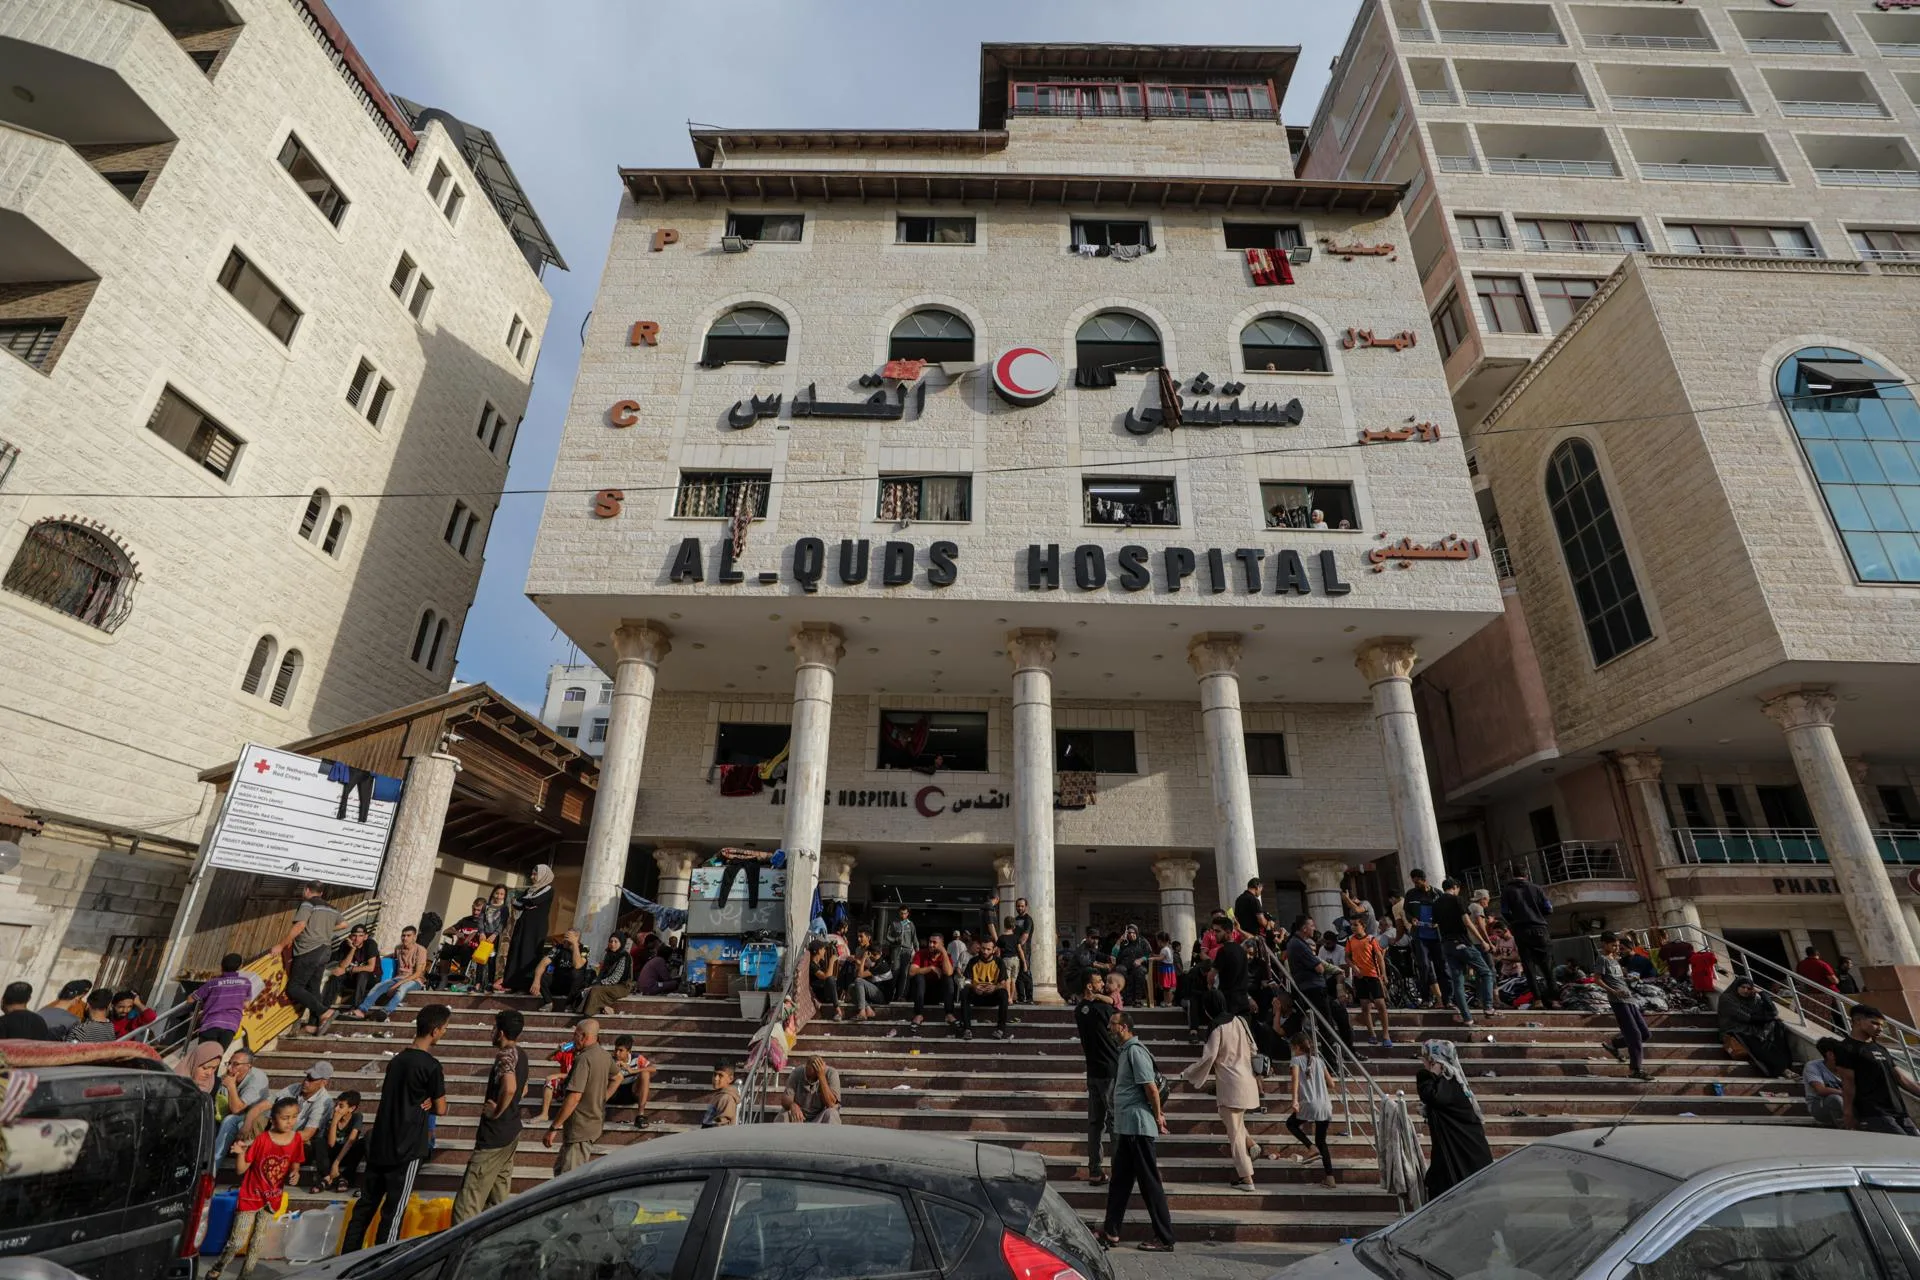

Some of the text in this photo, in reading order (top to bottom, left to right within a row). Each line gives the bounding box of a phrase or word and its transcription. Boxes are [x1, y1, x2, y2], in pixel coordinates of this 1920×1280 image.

[1343, 327, 1417, 350] الهلال
[728, 373, 926, 429] القدس
[1368, 531, 1480, 573] الفلسطيني
[1028, 544, 1351, 595] HOSPITAL
[287, 767, 318, 778] Netherlands
[838, 790, 908, 808] HOSPITAL
[952, 788, 1010, 813] القدس
